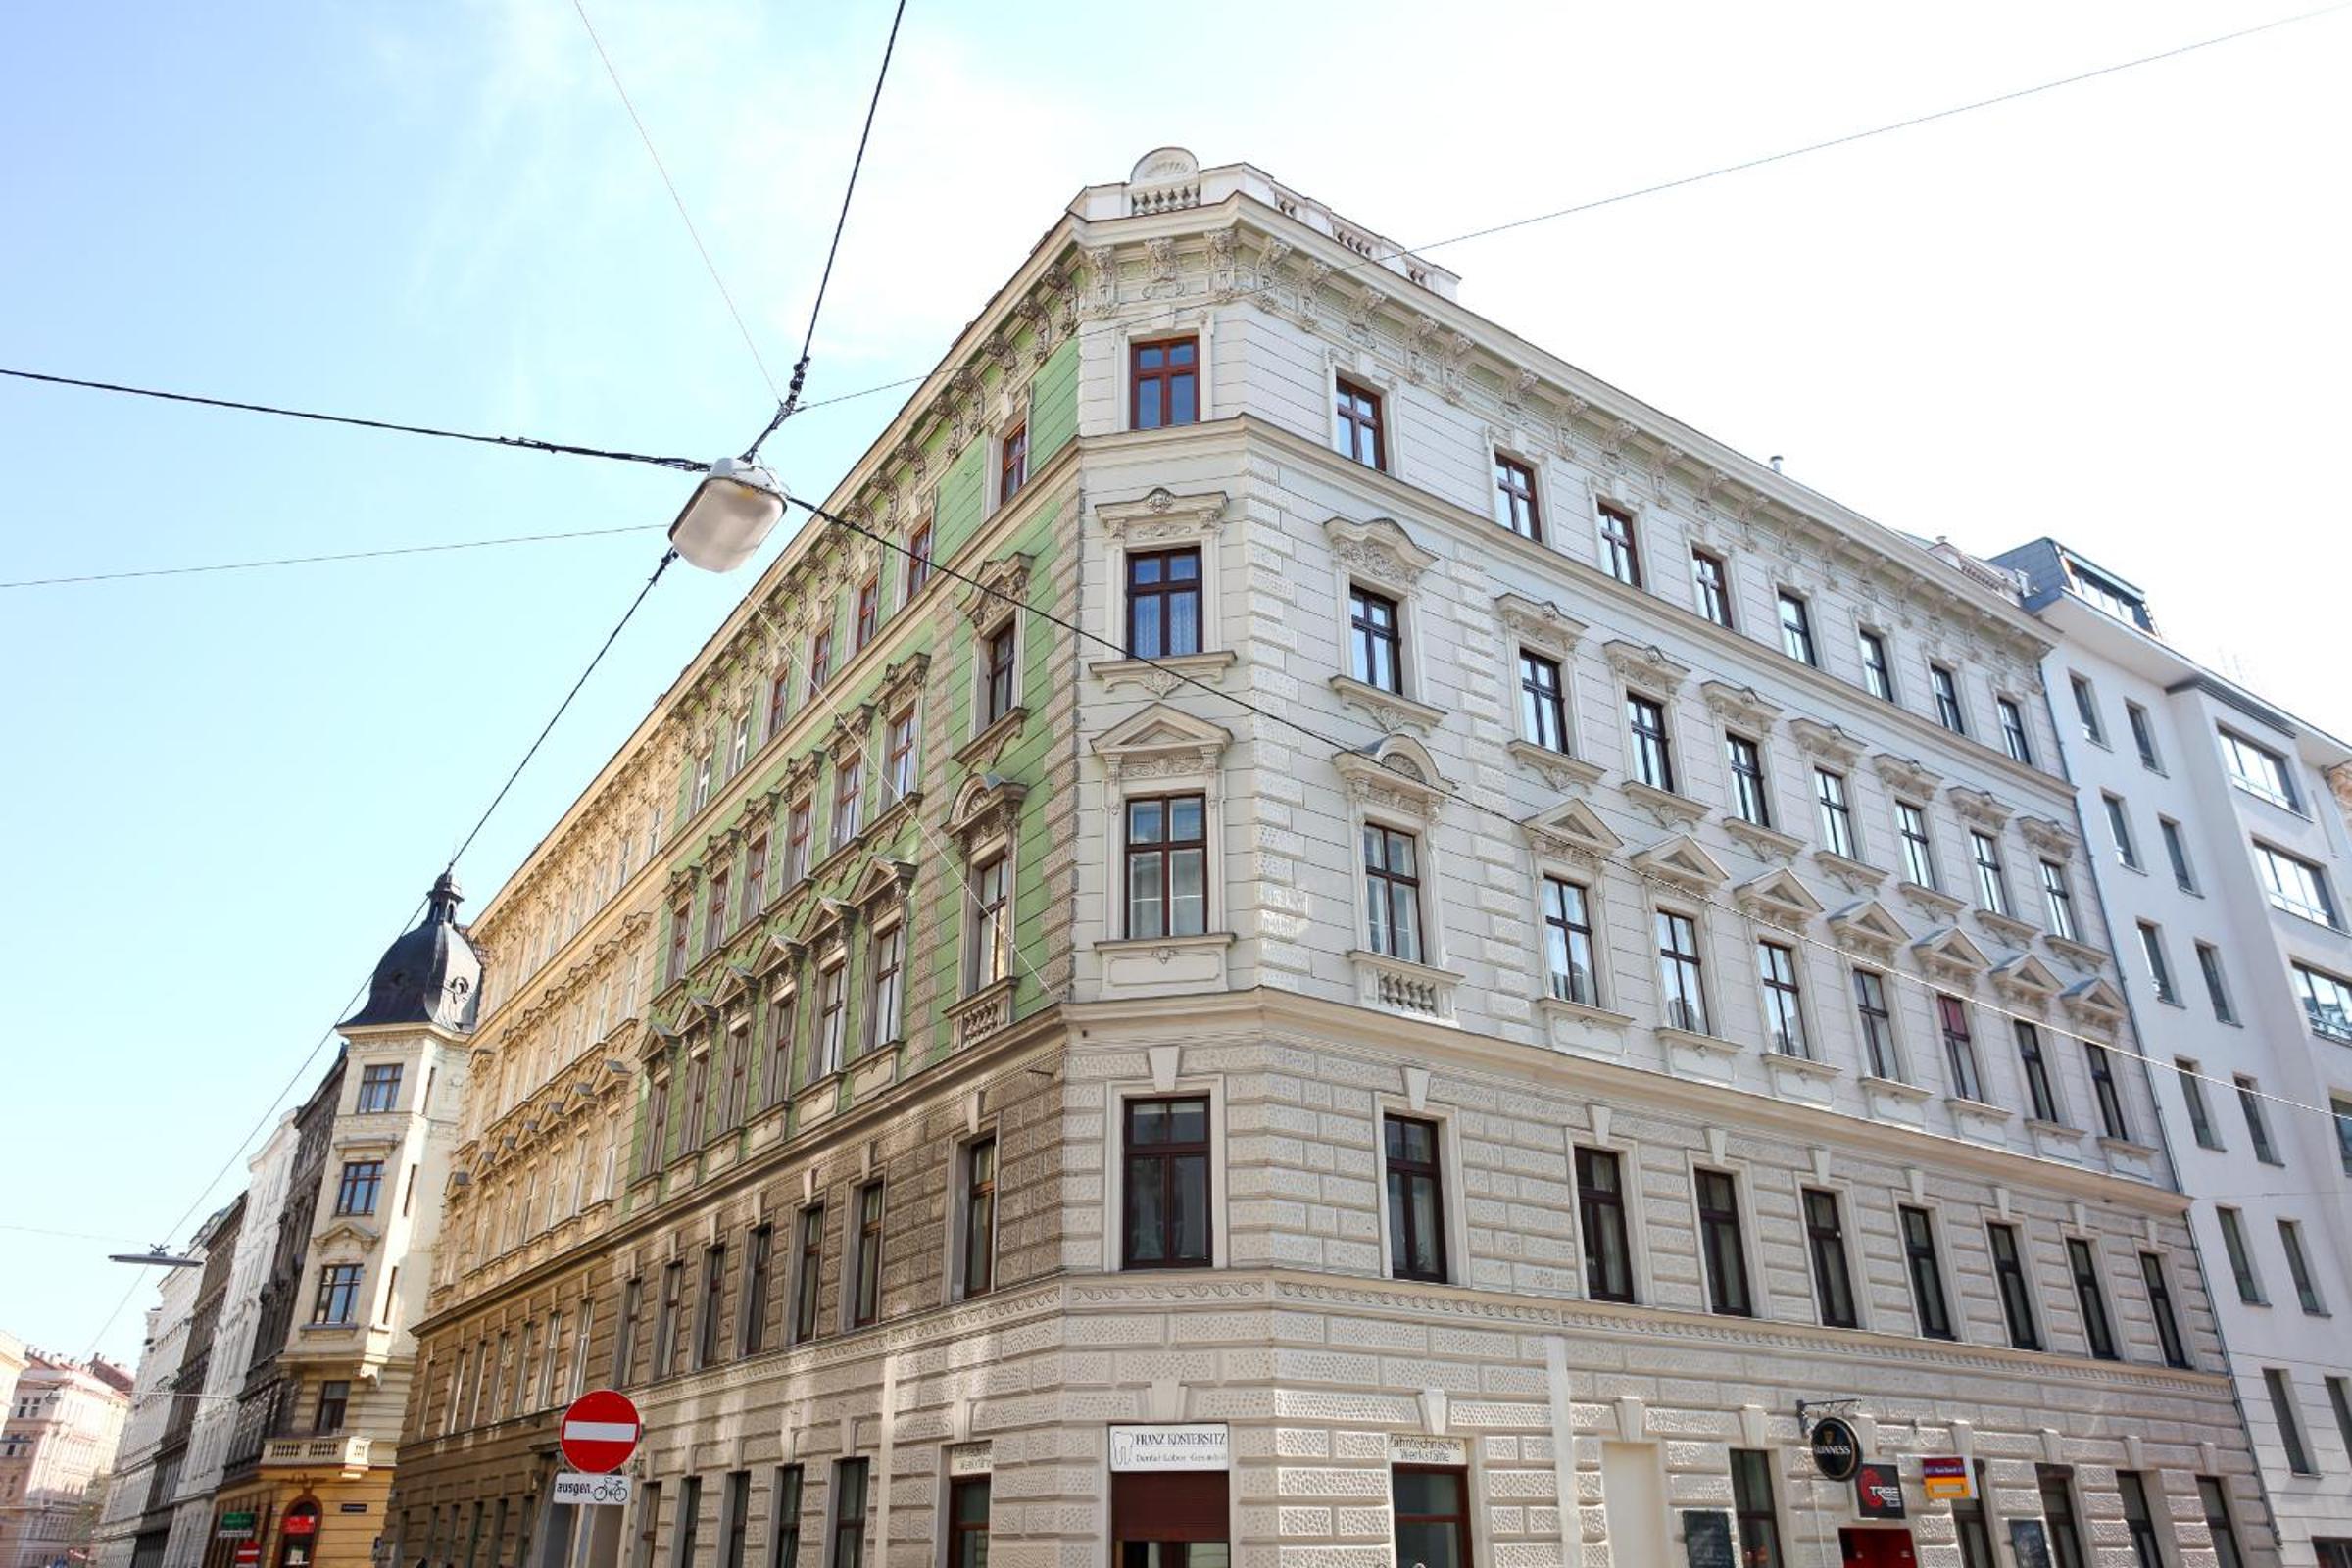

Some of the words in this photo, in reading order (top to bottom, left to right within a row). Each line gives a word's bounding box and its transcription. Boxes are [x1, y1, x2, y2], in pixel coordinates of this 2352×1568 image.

[1136, 1434, 1164, 1445] FRANZ
[1813, 1445, 1851, 1455] GUINNESS
[557, 1483, 593, 1496] ausgen.
